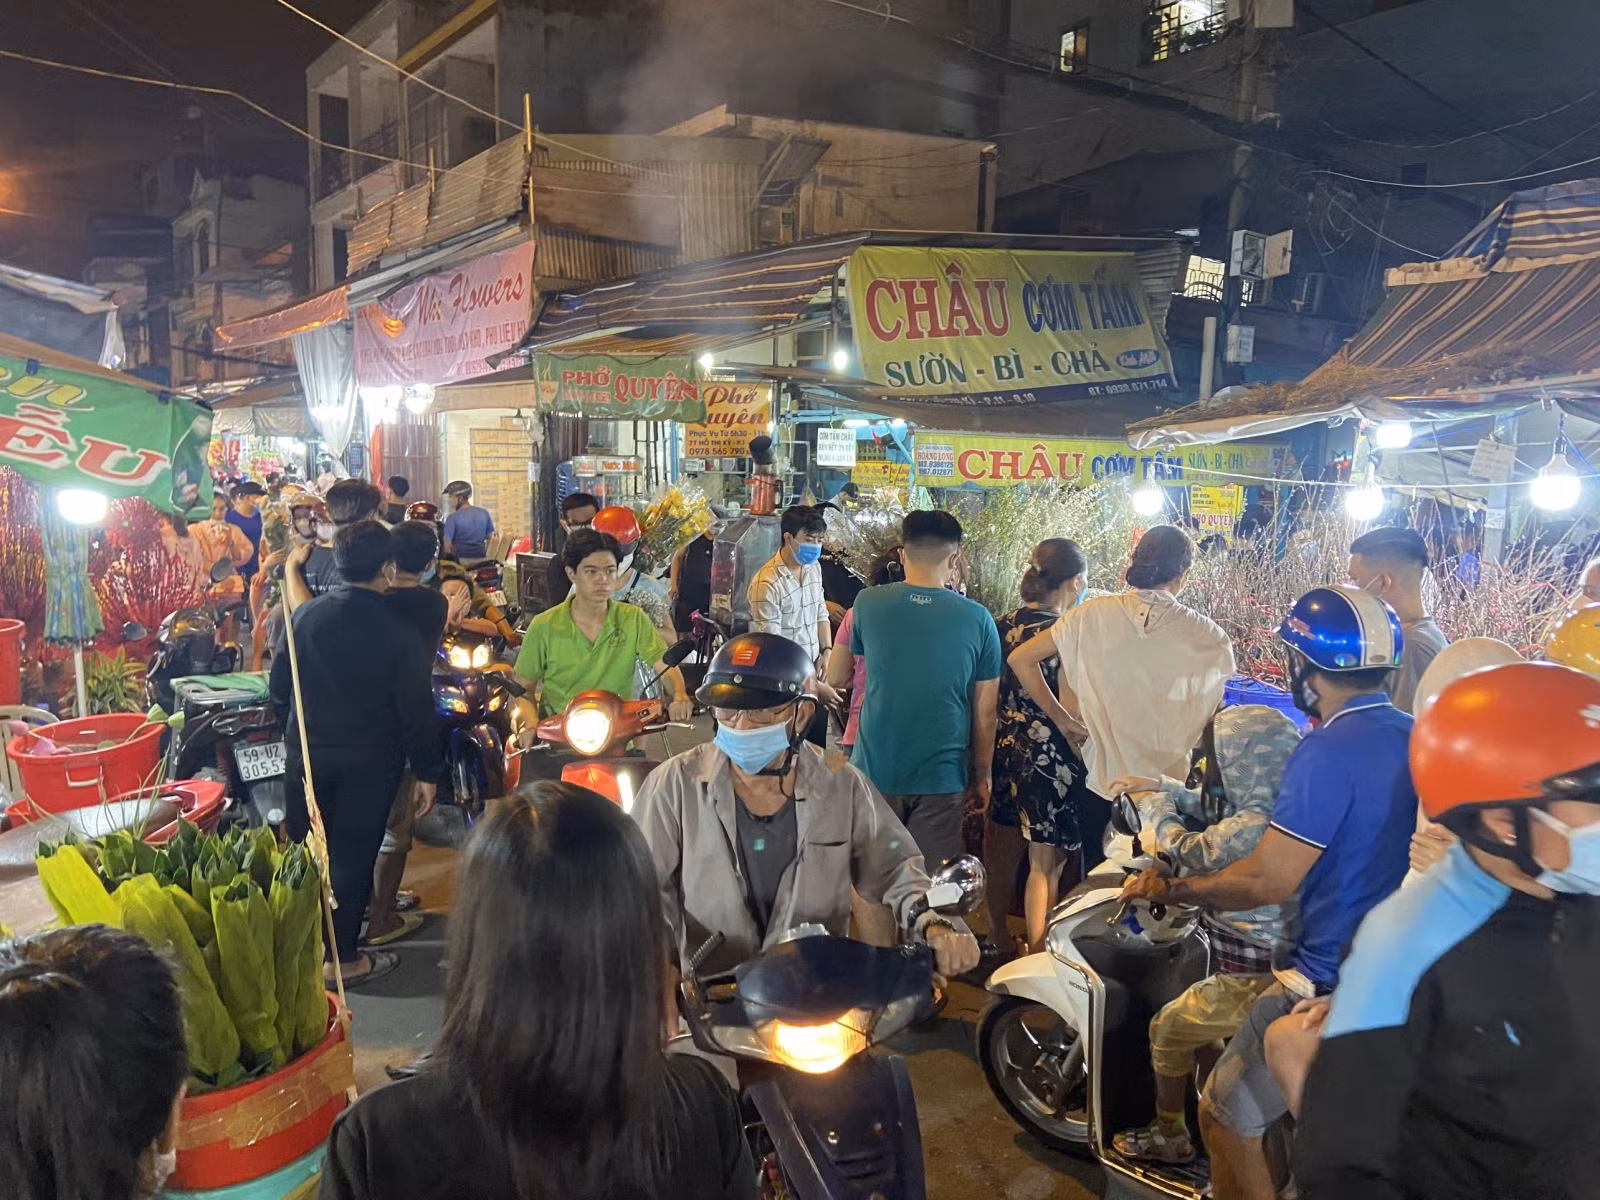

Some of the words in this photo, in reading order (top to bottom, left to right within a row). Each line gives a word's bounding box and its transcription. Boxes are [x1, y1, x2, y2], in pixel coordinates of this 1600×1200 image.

[448, 272, 526, 326] Flowers
[866, 260, 1010, 343] CHÂU
[1022, 273, 1082, 333] CƠM
[886, 352, 967, 388] SƯỜN
[993, 347, 1025, 382] BÌ
[1051, 341, 1111, 376] CHẢ
[561, 366, 612, 387] PHỞ
[614, 370, 699, 404] QUYÊN
[698, 408, 765, 429] uyên
[689, 447, 710, 455] 0978
[712, 447, 728, 455] 565
[957, 441, 1084, 480] CHÂU
